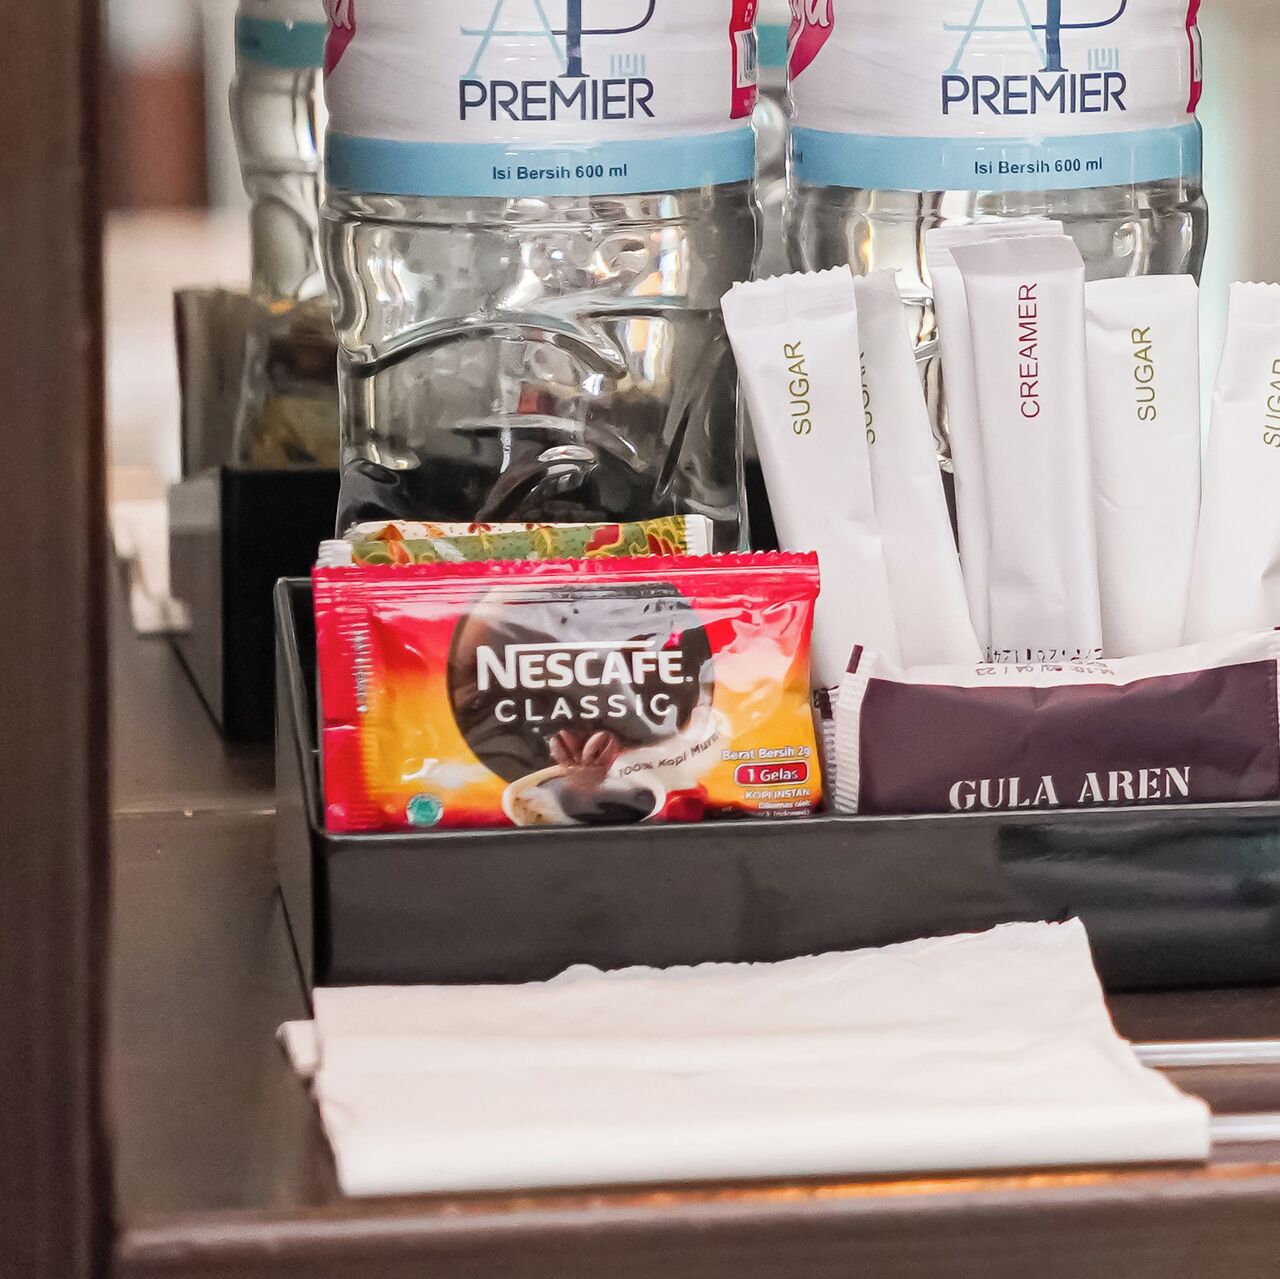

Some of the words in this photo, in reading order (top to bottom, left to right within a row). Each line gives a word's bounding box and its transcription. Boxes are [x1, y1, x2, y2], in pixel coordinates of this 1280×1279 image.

[459, 77, 655, 120] PREMIER
[942, 72, 1127, 115] PREMIER
[492, 166, 511, 179] Isi
[517, 166, 570, 179] Bersih
[575, 165, 604, 178] 600
[609, 164, 628, 177] ml
[974, 161, 993, 174] Isi
[998, 160, 1050, 174] Bersih
[1054, 159, 1081, 172] 600
[1085, 157, 1103, 171] ml
[1018, 282, 1041, 419] CREAMER
[783, 341, 812, 435] SUGAR
[1131, 326, 1157, 421] SUGAR
[493, 693, 672, 723] CLASSIC
[747, 768, 755, 782] 1
[759, 767, 798, 782] Gelas
[758, 747, 794, 760] Bersih
[947, 776, 1059, 810] GULA
[1079, 766, 1191, 802] AREN
